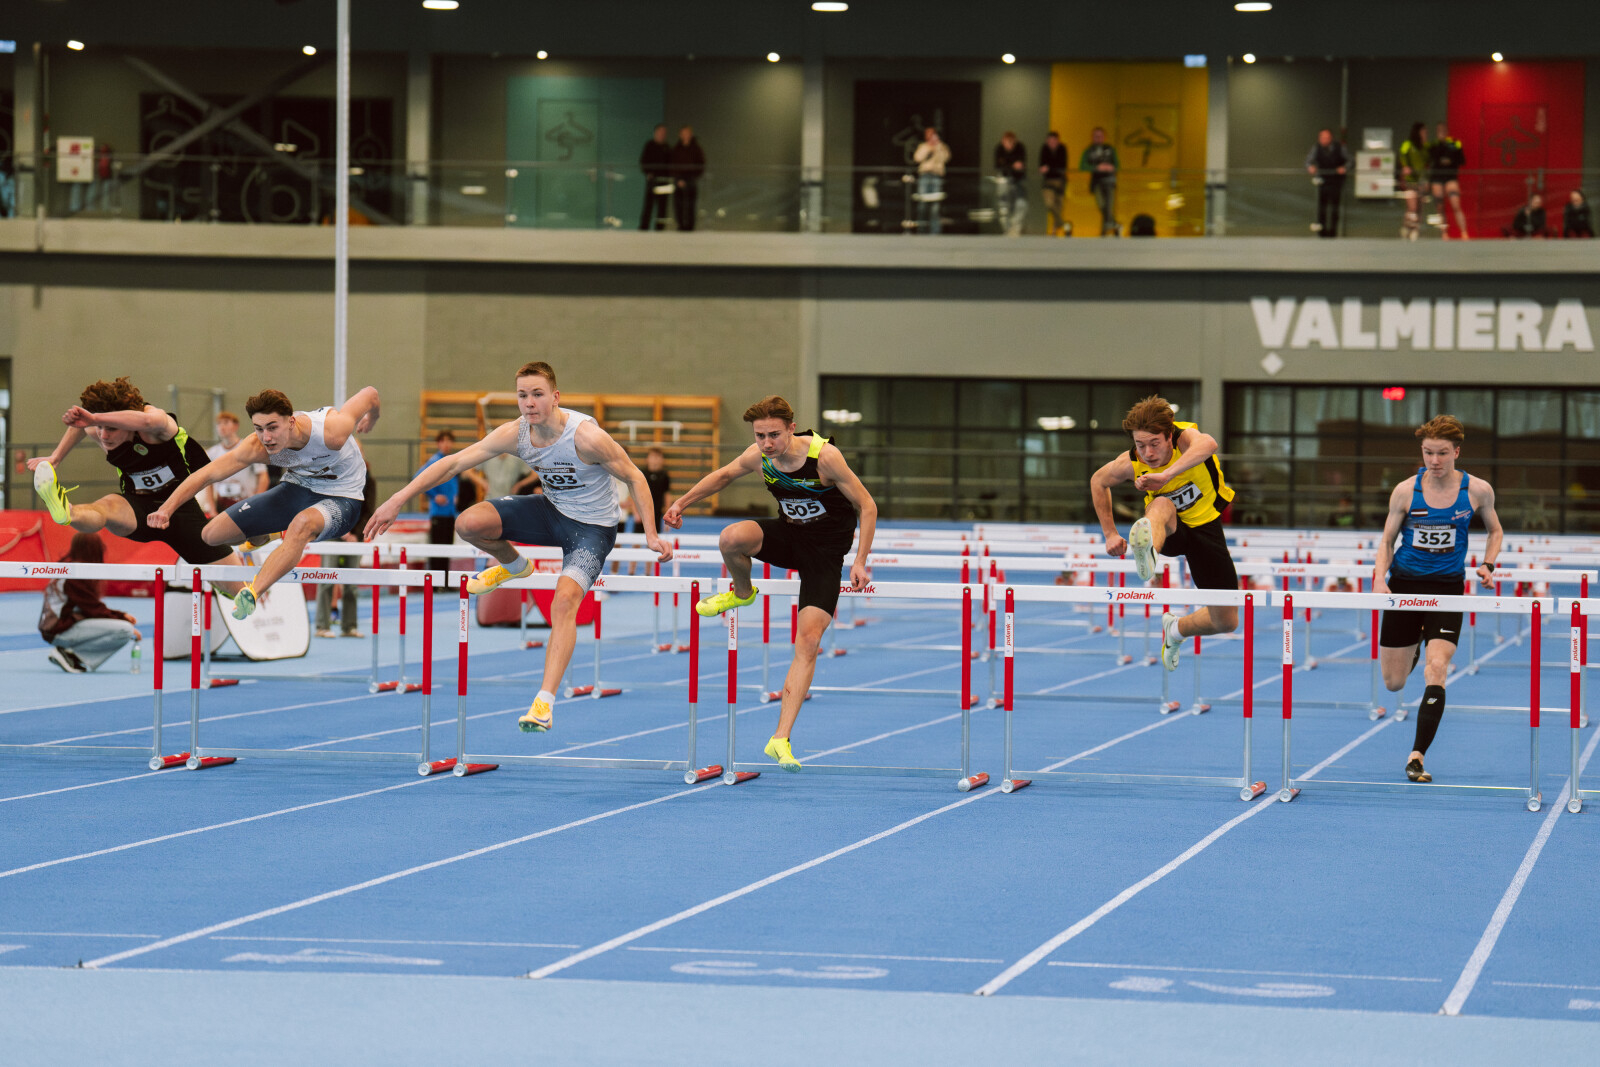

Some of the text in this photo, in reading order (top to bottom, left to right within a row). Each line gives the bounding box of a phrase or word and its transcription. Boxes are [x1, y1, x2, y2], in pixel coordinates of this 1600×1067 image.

[1250, 296, 1595, 351] VALMIERA
[141, 473, 163, 487] 81
[785, 502, 820, 517] 505
[1418, 530, 1451, 545] 352
[31, 565, 70, 577] polanik
[301, 570, 339, 581] polanik
[1116, 590, 1155, 602] polanik
[1398, 596, 1439, 609] polanik
